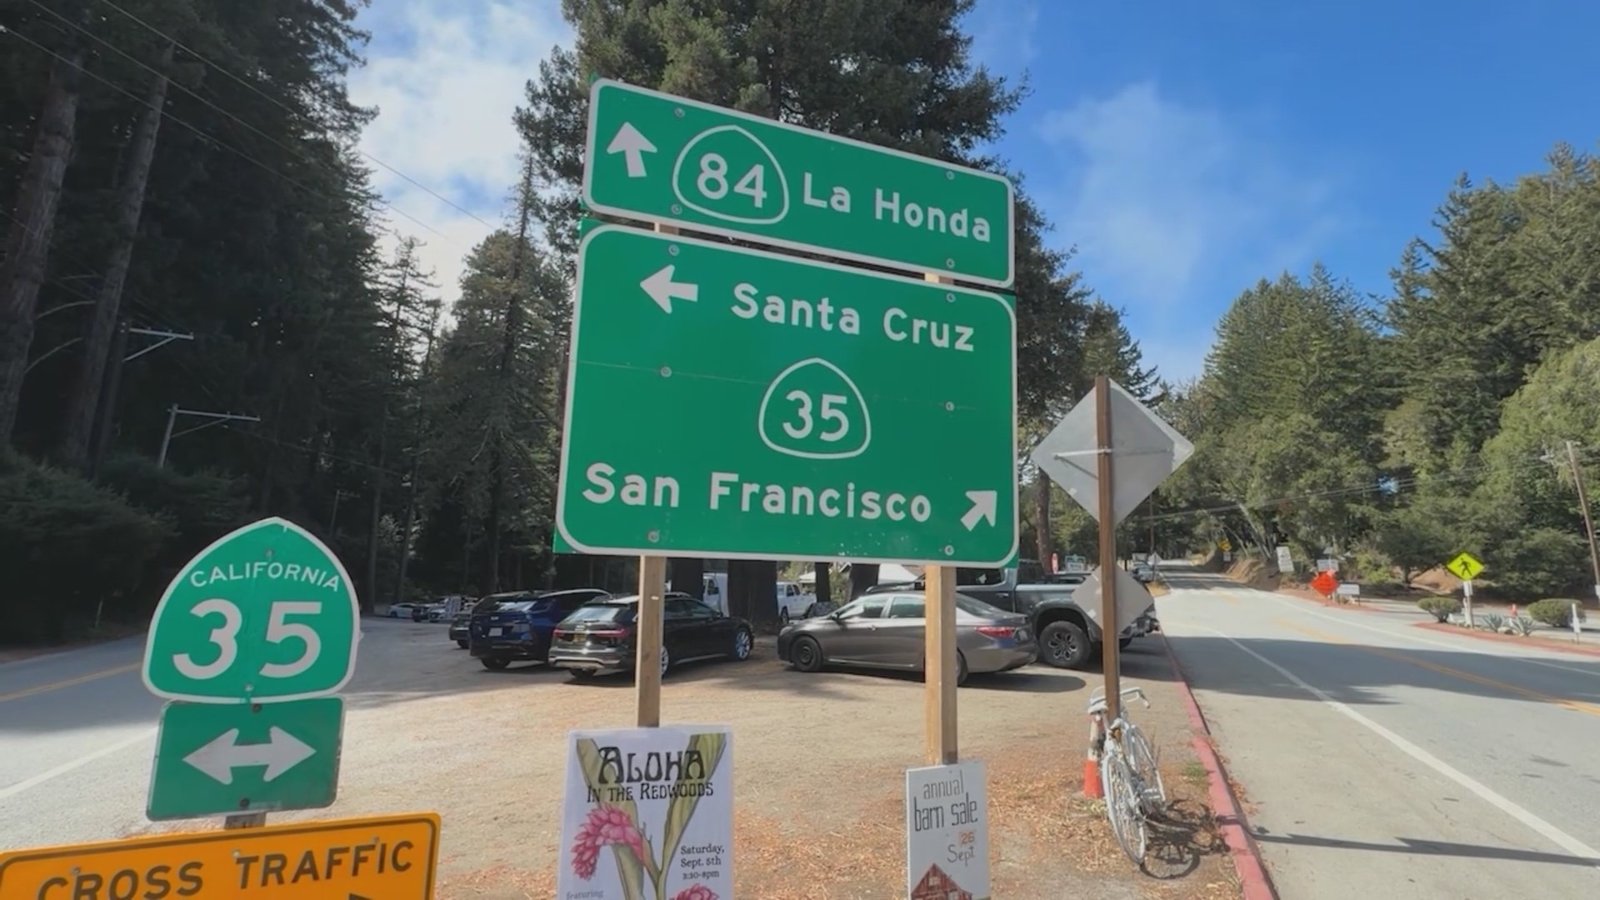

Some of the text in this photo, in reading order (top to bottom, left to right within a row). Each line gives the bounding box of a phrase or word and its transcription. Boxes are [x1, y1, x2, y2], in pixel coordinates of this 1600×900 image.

[696, 152, 767, 208] 84
[803, 172, 992, 242] La Honda
[731, 282, 975, 352] Santa Cruz
[782, 389, 850, 443] 35
[582, 462, 932, 523] San Francisco
[190, 561, 341, 592] CALIFORNIA
[172, 598, 323, 680] 35
[598, 746, 706, 784] ALOHA
[923, 769, 965, 800] annual
[607, 786, 634, 801] THE
[640, 782, 714, 801] REDWOODS
[913, 792, 979, 832] barn sale
[680, 843, 725, 855] Saturday,
[680, 855, 722, 869] Sept. 5th
[946, 844, 975, 867] Sept
[37, 840, 414, 900] CROSS TRAFFIC
